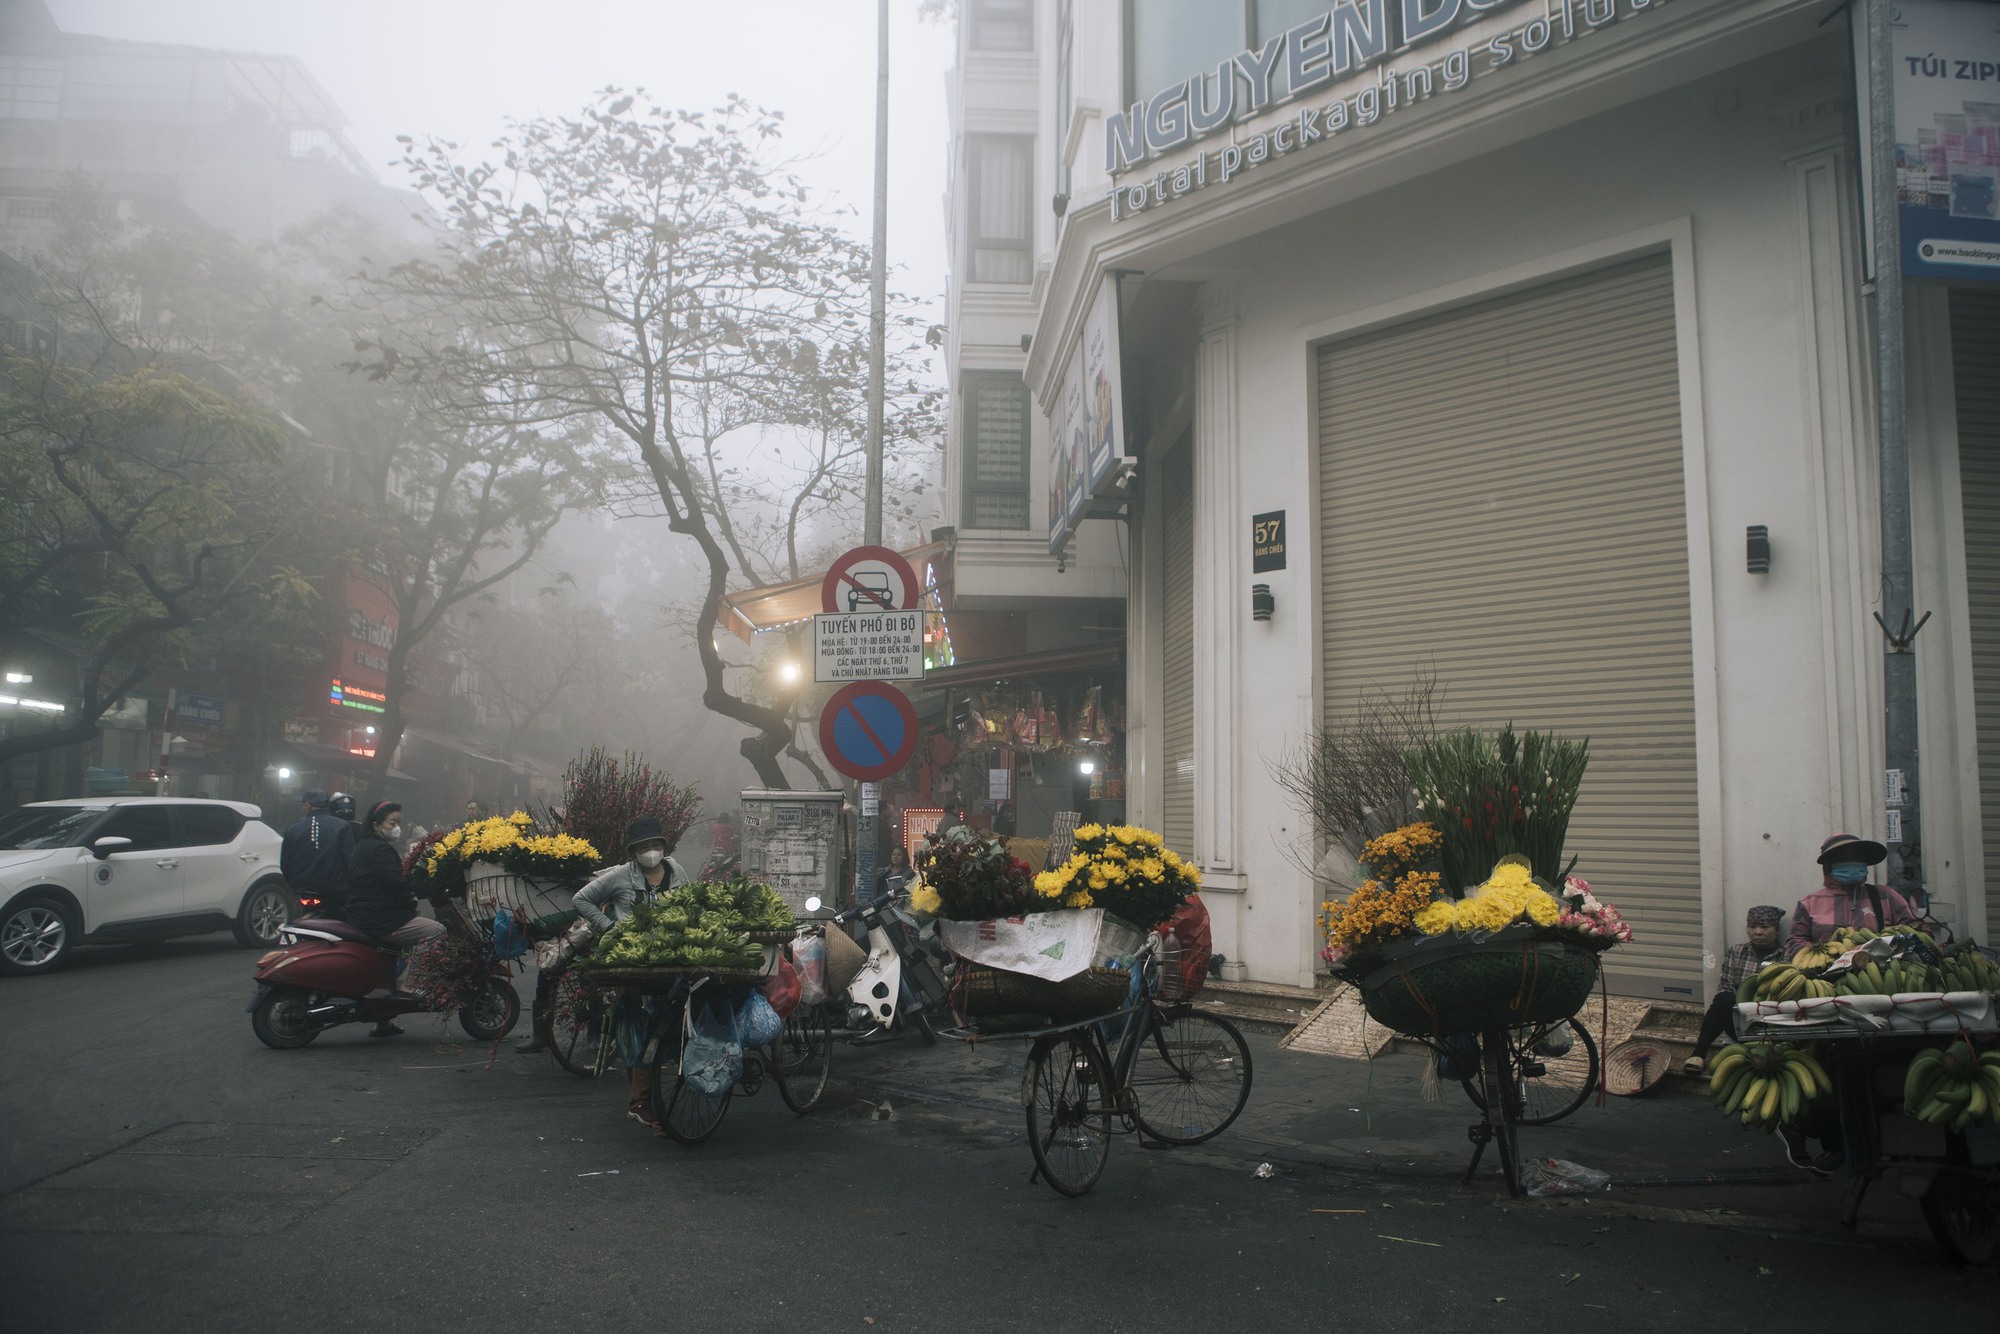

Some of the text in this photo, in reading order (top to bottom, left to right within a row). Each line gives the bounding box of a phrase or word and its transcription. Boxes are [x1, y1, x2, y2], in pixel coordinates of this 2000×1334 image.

[1904, 53, 1947, 78] TÚI
[1105, 0, 1387, 175] NGUYEN
[1106, 150, 1206, 223] Total
[1222, 45, 1473, 184] packaging
[1255, 519, 1281, 544] 57
[821, 613, 916, 634] TUYẾN PHỐ ĐI BỘ
[860, 637, 878, 645] 19:00
[893, 636, 911, 644] 24:00
[869, 646, 886, 654] 18:00
[902, 645, 920, 653] 24:00
[837, 657, 850, 667] CÁC
[851, 657, 868, 667] NGÀY
[869, 655, 883, 666] THỨ
[891, 655, 904, 665] THỨ
[904, 656, 909, 664] 7
[831, 669, 840, 678] VÀ
[840, 666, 854, 677] CHỦ
[855, 667, 872, 678] NHẬT
[873, 667, 891, 676] HÀNG
[909, 815, 944, 834] NHÀ TH
